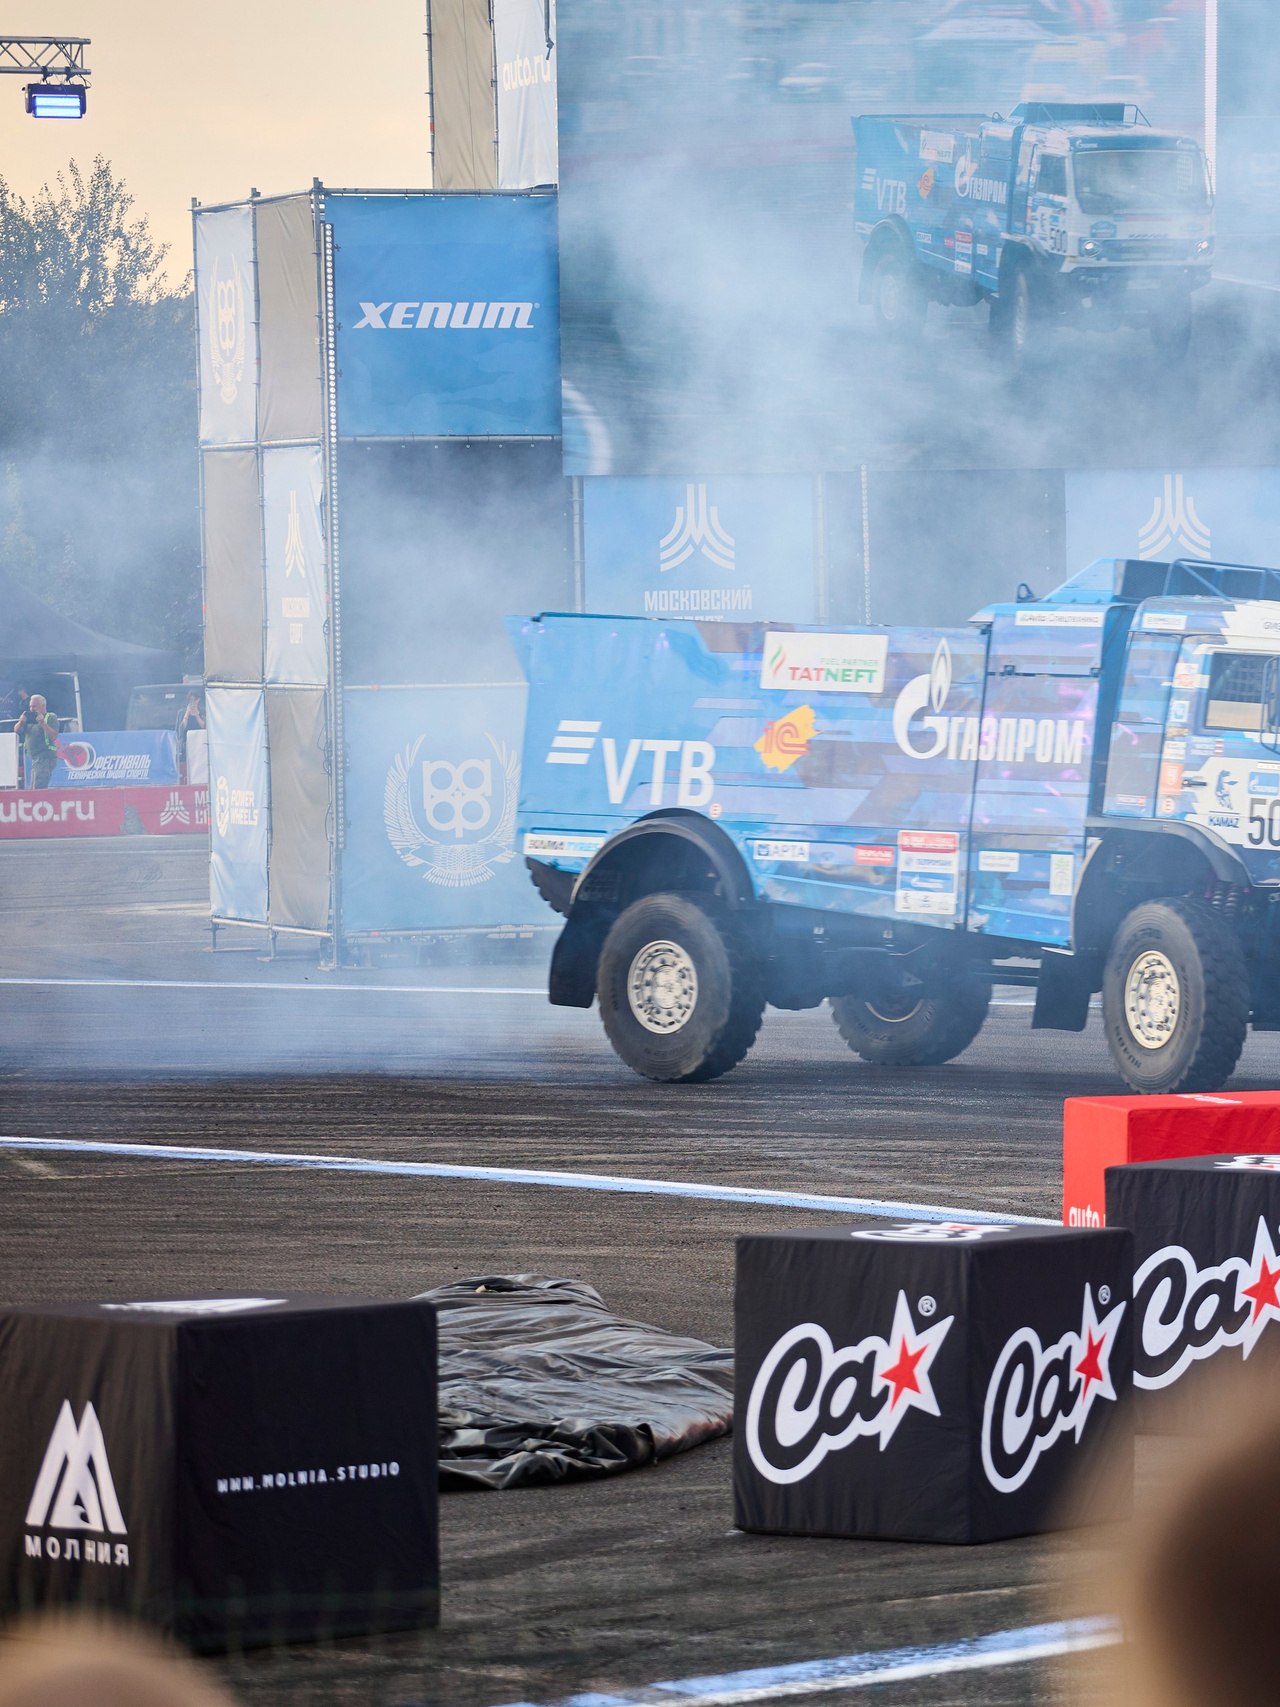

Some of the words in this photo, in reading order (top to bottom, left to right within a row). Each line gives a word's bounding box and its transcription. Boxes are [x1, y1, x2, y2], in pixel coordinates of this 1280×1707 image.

[503, 54, 551, 91] auto.ru
[644, 585, 752, 612] МОСКОВСКИЙ
[789, 667, 878, 683] TATNEFT
[948, 716, 1086, 764] ГАЗПРОМ
[94, 754, 151, 770] ФЕСТИВАЛЬ
[602, 738, 716, 807] VTB
[0, 799, 95, 822] uto.ru
[217, 1461, 400, 1494] WWW.MOLNIA.STUDIO
[25, 1534, 130, 1566] МОЛНИЯ
